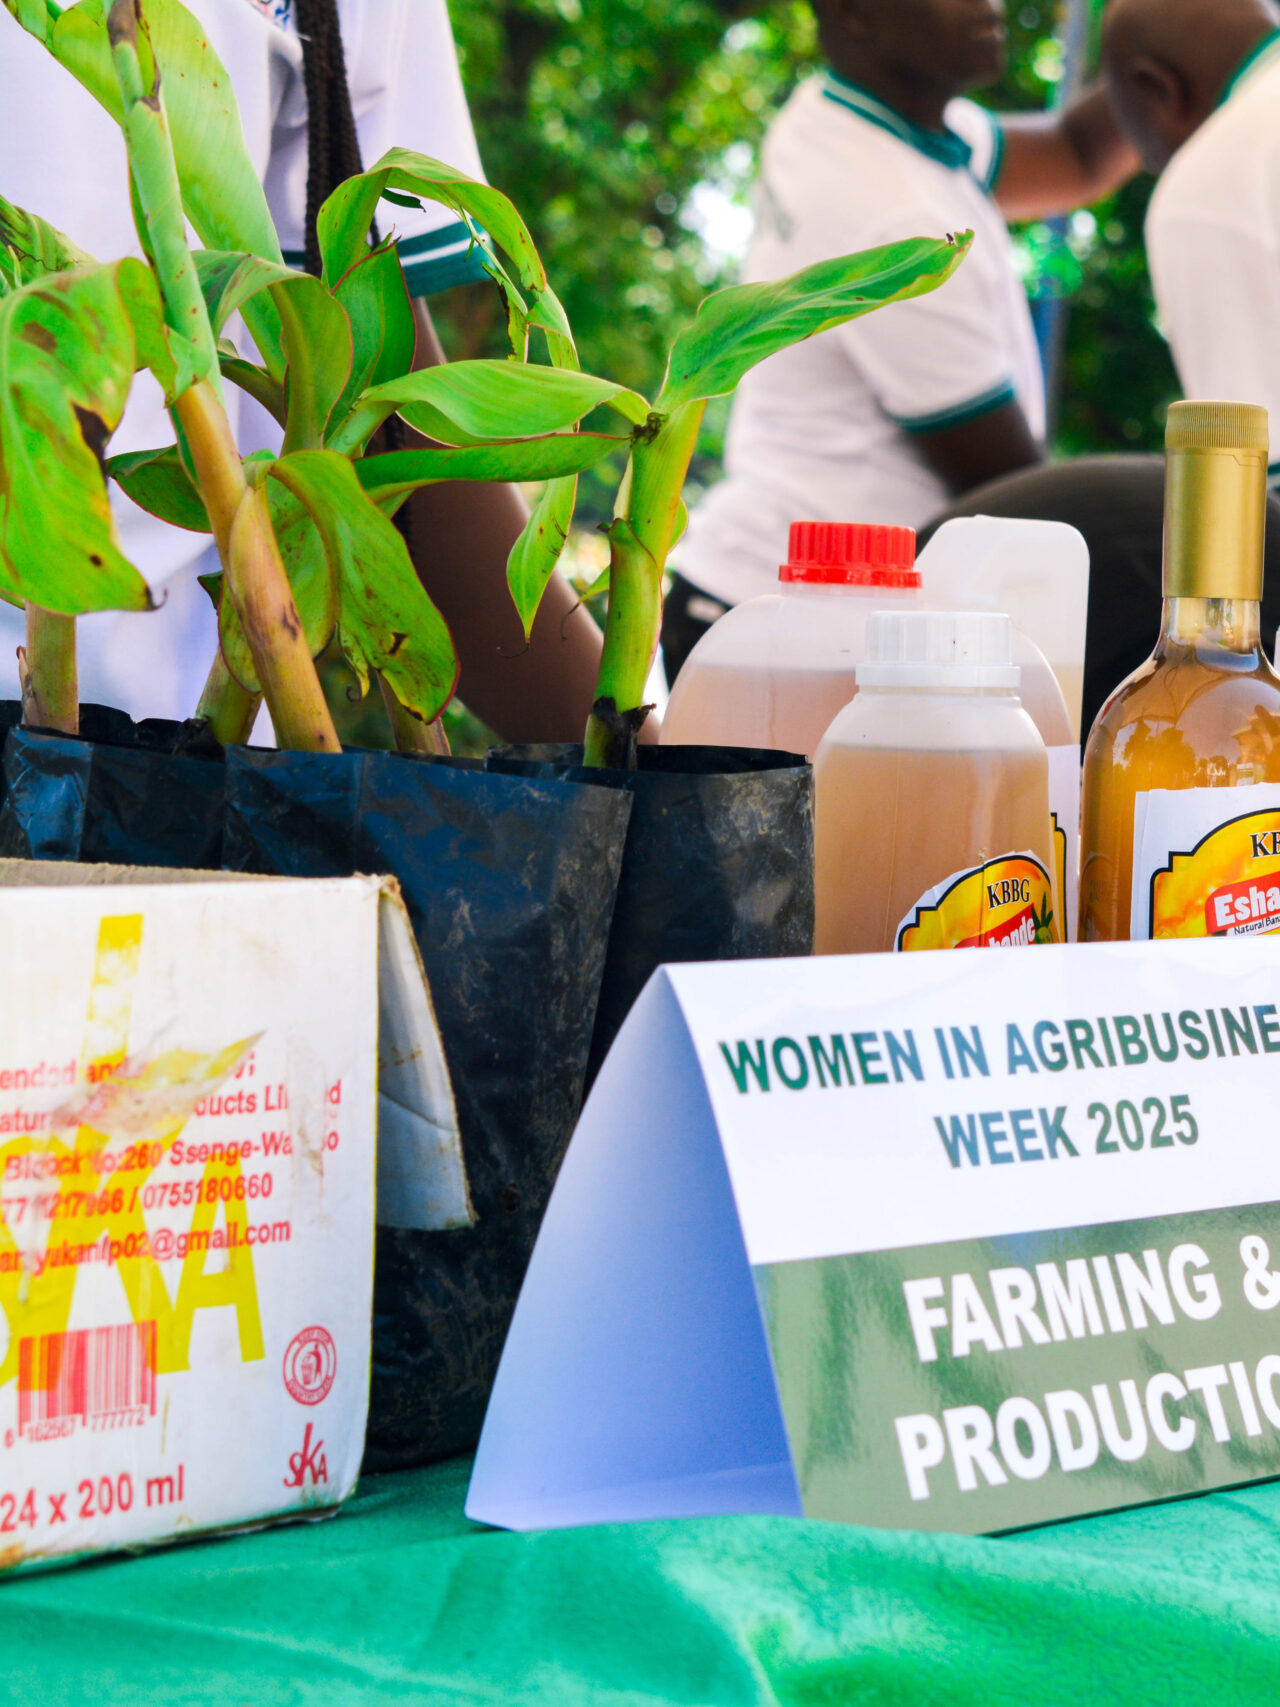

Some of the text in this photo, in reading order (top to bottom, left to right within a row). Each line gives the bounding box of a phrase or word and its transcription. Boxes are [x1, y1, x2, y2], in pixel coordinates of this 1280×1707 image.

[986, 878, 1031, 910] KBBG
[1234, 920, 1265, 936] Natural
[718, 1029, 925, 1094] WOMEN
[938, 1025, 991, 1079] IN
[934, 1092, 1200, 1168] WEEK 2025
[143, 1172, 273, 1210] 0755180660
[902, 1241, 1223, 1363] FARMING
[91, 1407, 145, 1433] 777772
[283, 1422, 328, 1488] SKA
[0, 1462, 184, 1533] 24 x 200 ml
